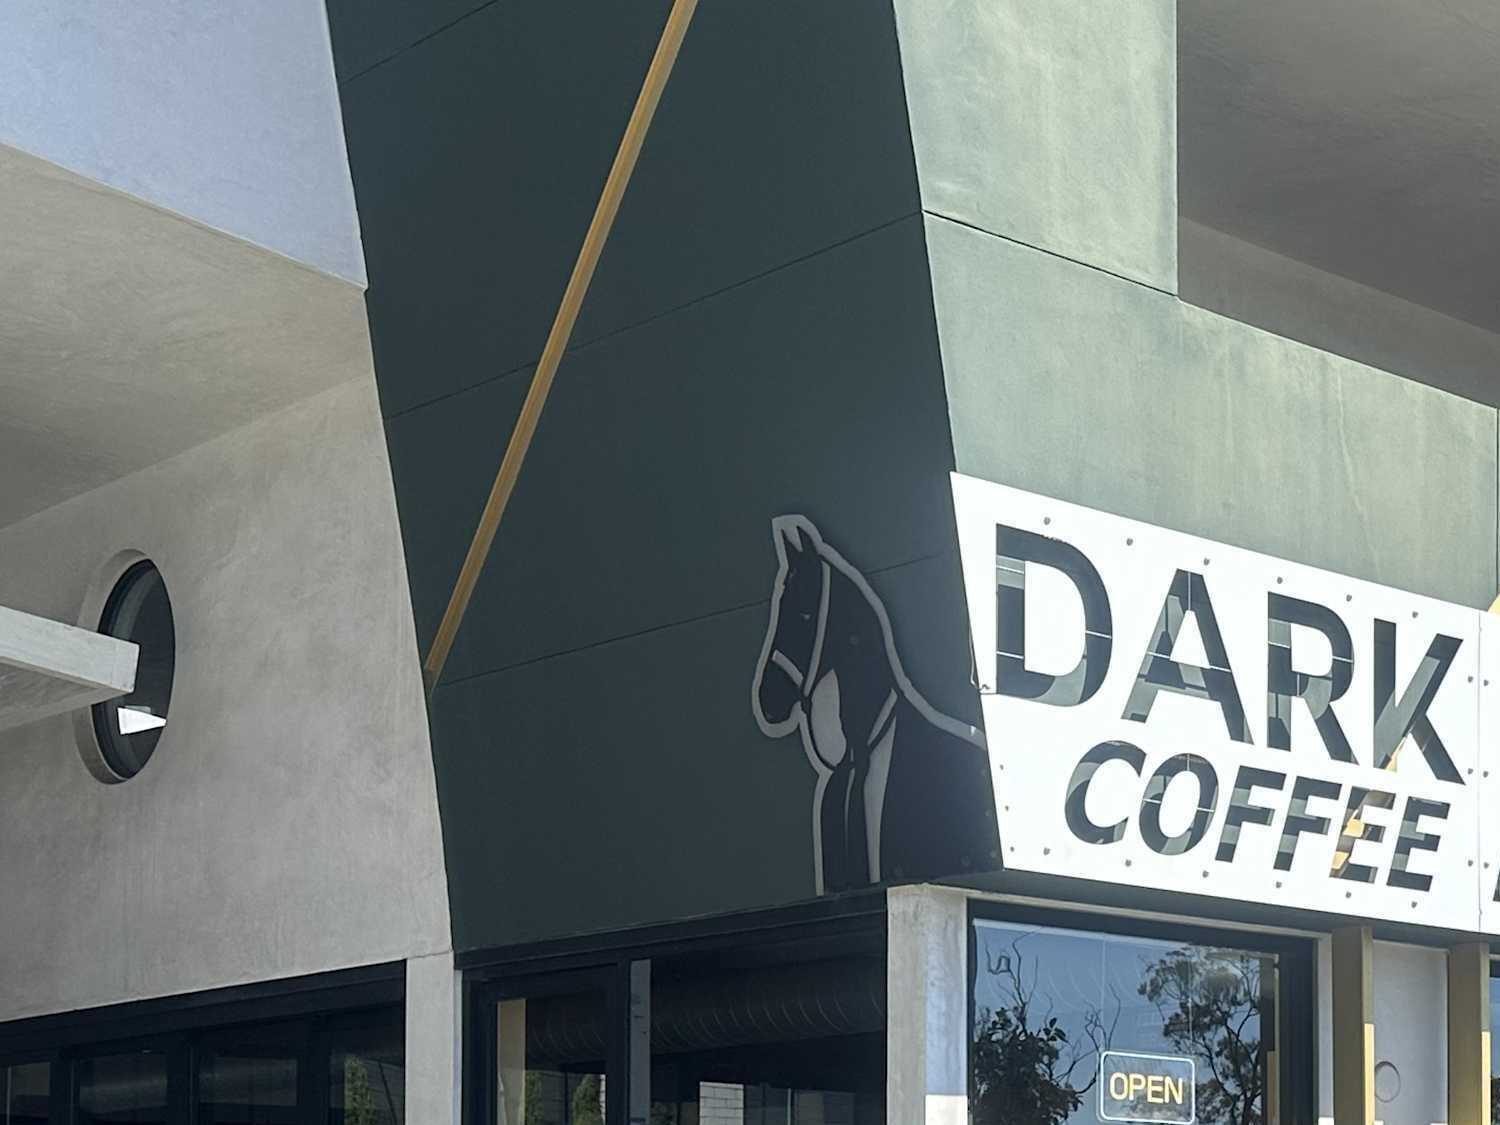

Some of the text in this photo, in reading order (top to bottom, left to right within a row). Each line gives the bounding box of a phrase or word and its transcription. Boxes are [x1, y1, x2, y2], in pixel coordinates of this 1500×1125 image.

[995, 522, 1466, 786] DARK
[1064, 740, 1451, 892] COFFEE
[1109, 1072, 1184, 1105] OPEN
